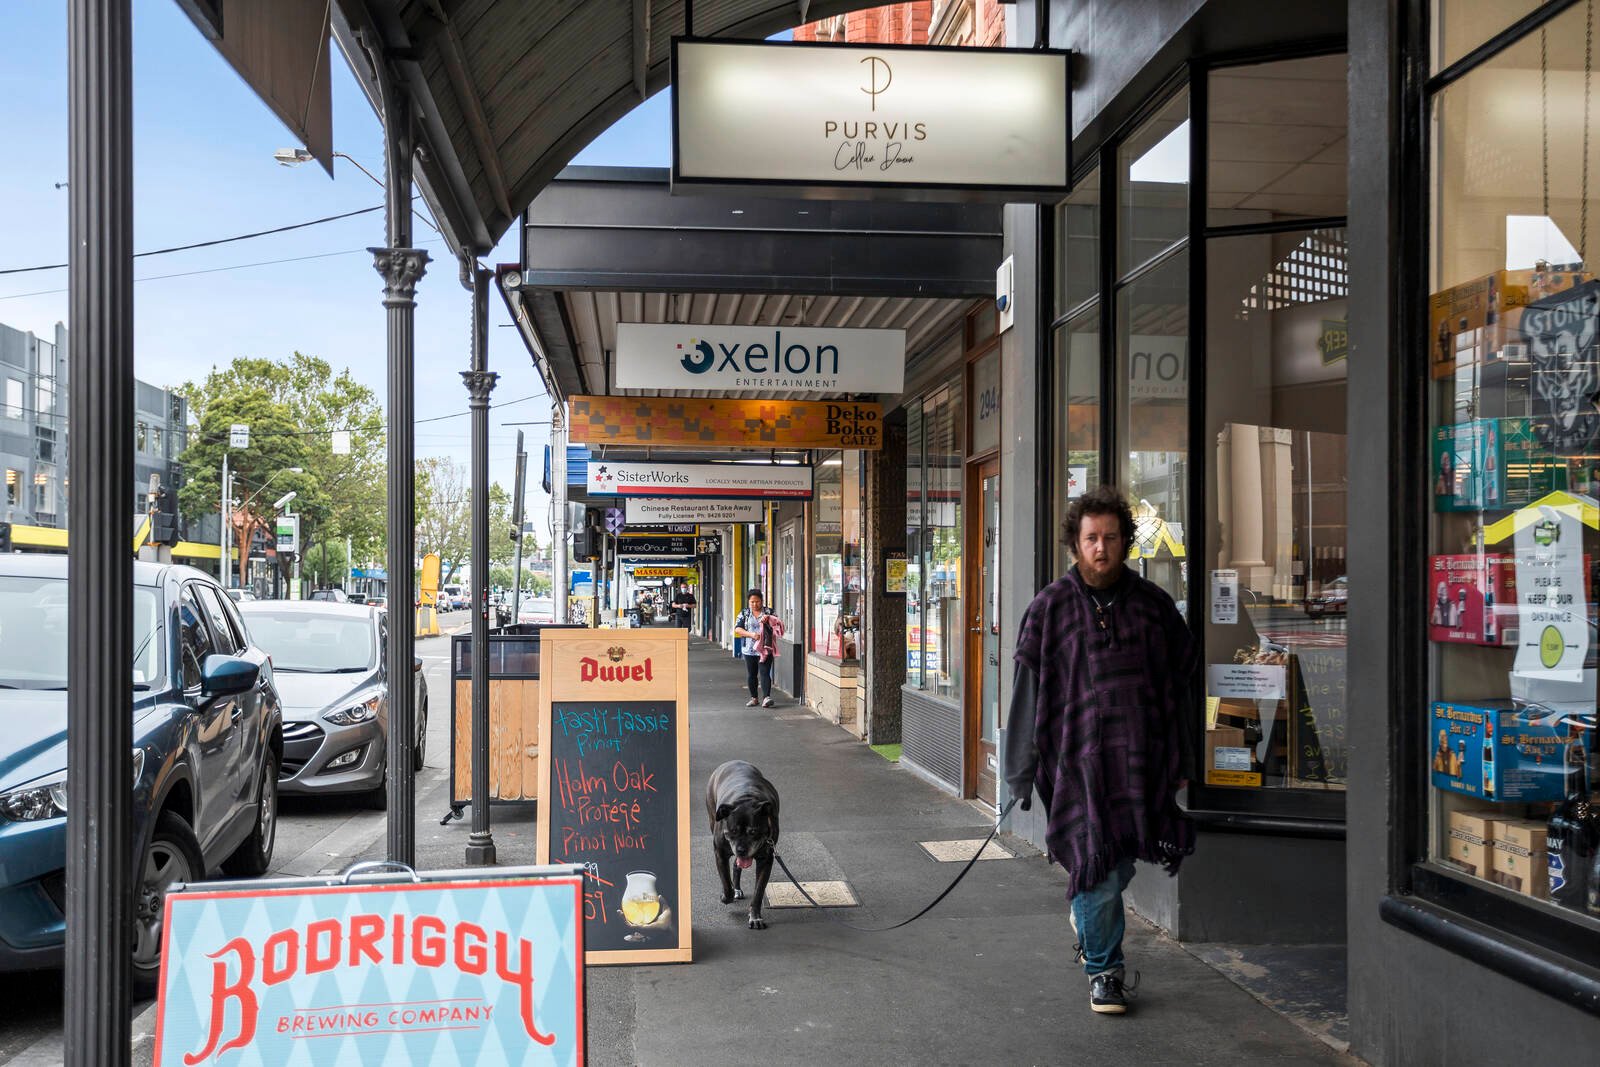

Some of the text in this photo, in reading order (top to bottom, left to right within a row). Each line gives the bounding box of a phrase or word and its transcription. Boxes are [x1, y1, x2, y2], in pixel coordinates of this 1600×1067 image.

[825, 121, 927, 141] PURVIS
[834, 141, 914, 172] Cellar Door
[1533, 295, 1593, 336] STONE
[736, 379, 838, 388] ENTERTAINMENT
[825, 405, 877, 421] Deko
[825, 420, 877, 437] Boko
[840, 435, 877, 446] CAFE
[617, 470, 690, 484] SisterWorks
[641, 504, 670, 513] Chinese
[671, 505, 710, 513] Restaurant
[716, 505, 734, 513] Take
[733, 505, 752, 514] Away
[658, 513, 672, 521] Fully
[1534, 576, 1563, 588] PLEASE
[1527, 595, 1548, 606] KEEP
[1531, 612, 1573, 623] DISTANCE
[579, 656, 654, 683] Duvel
[611, 708, 670, 737] tassie
[555, 757, 657, 809] Holm Oak
[562, 826, 649, 856] Pinot Noir
[183, 913, 556, 1067] BODRIGGY
[276, 1004, 494, 1033] BREWING COMPANY
